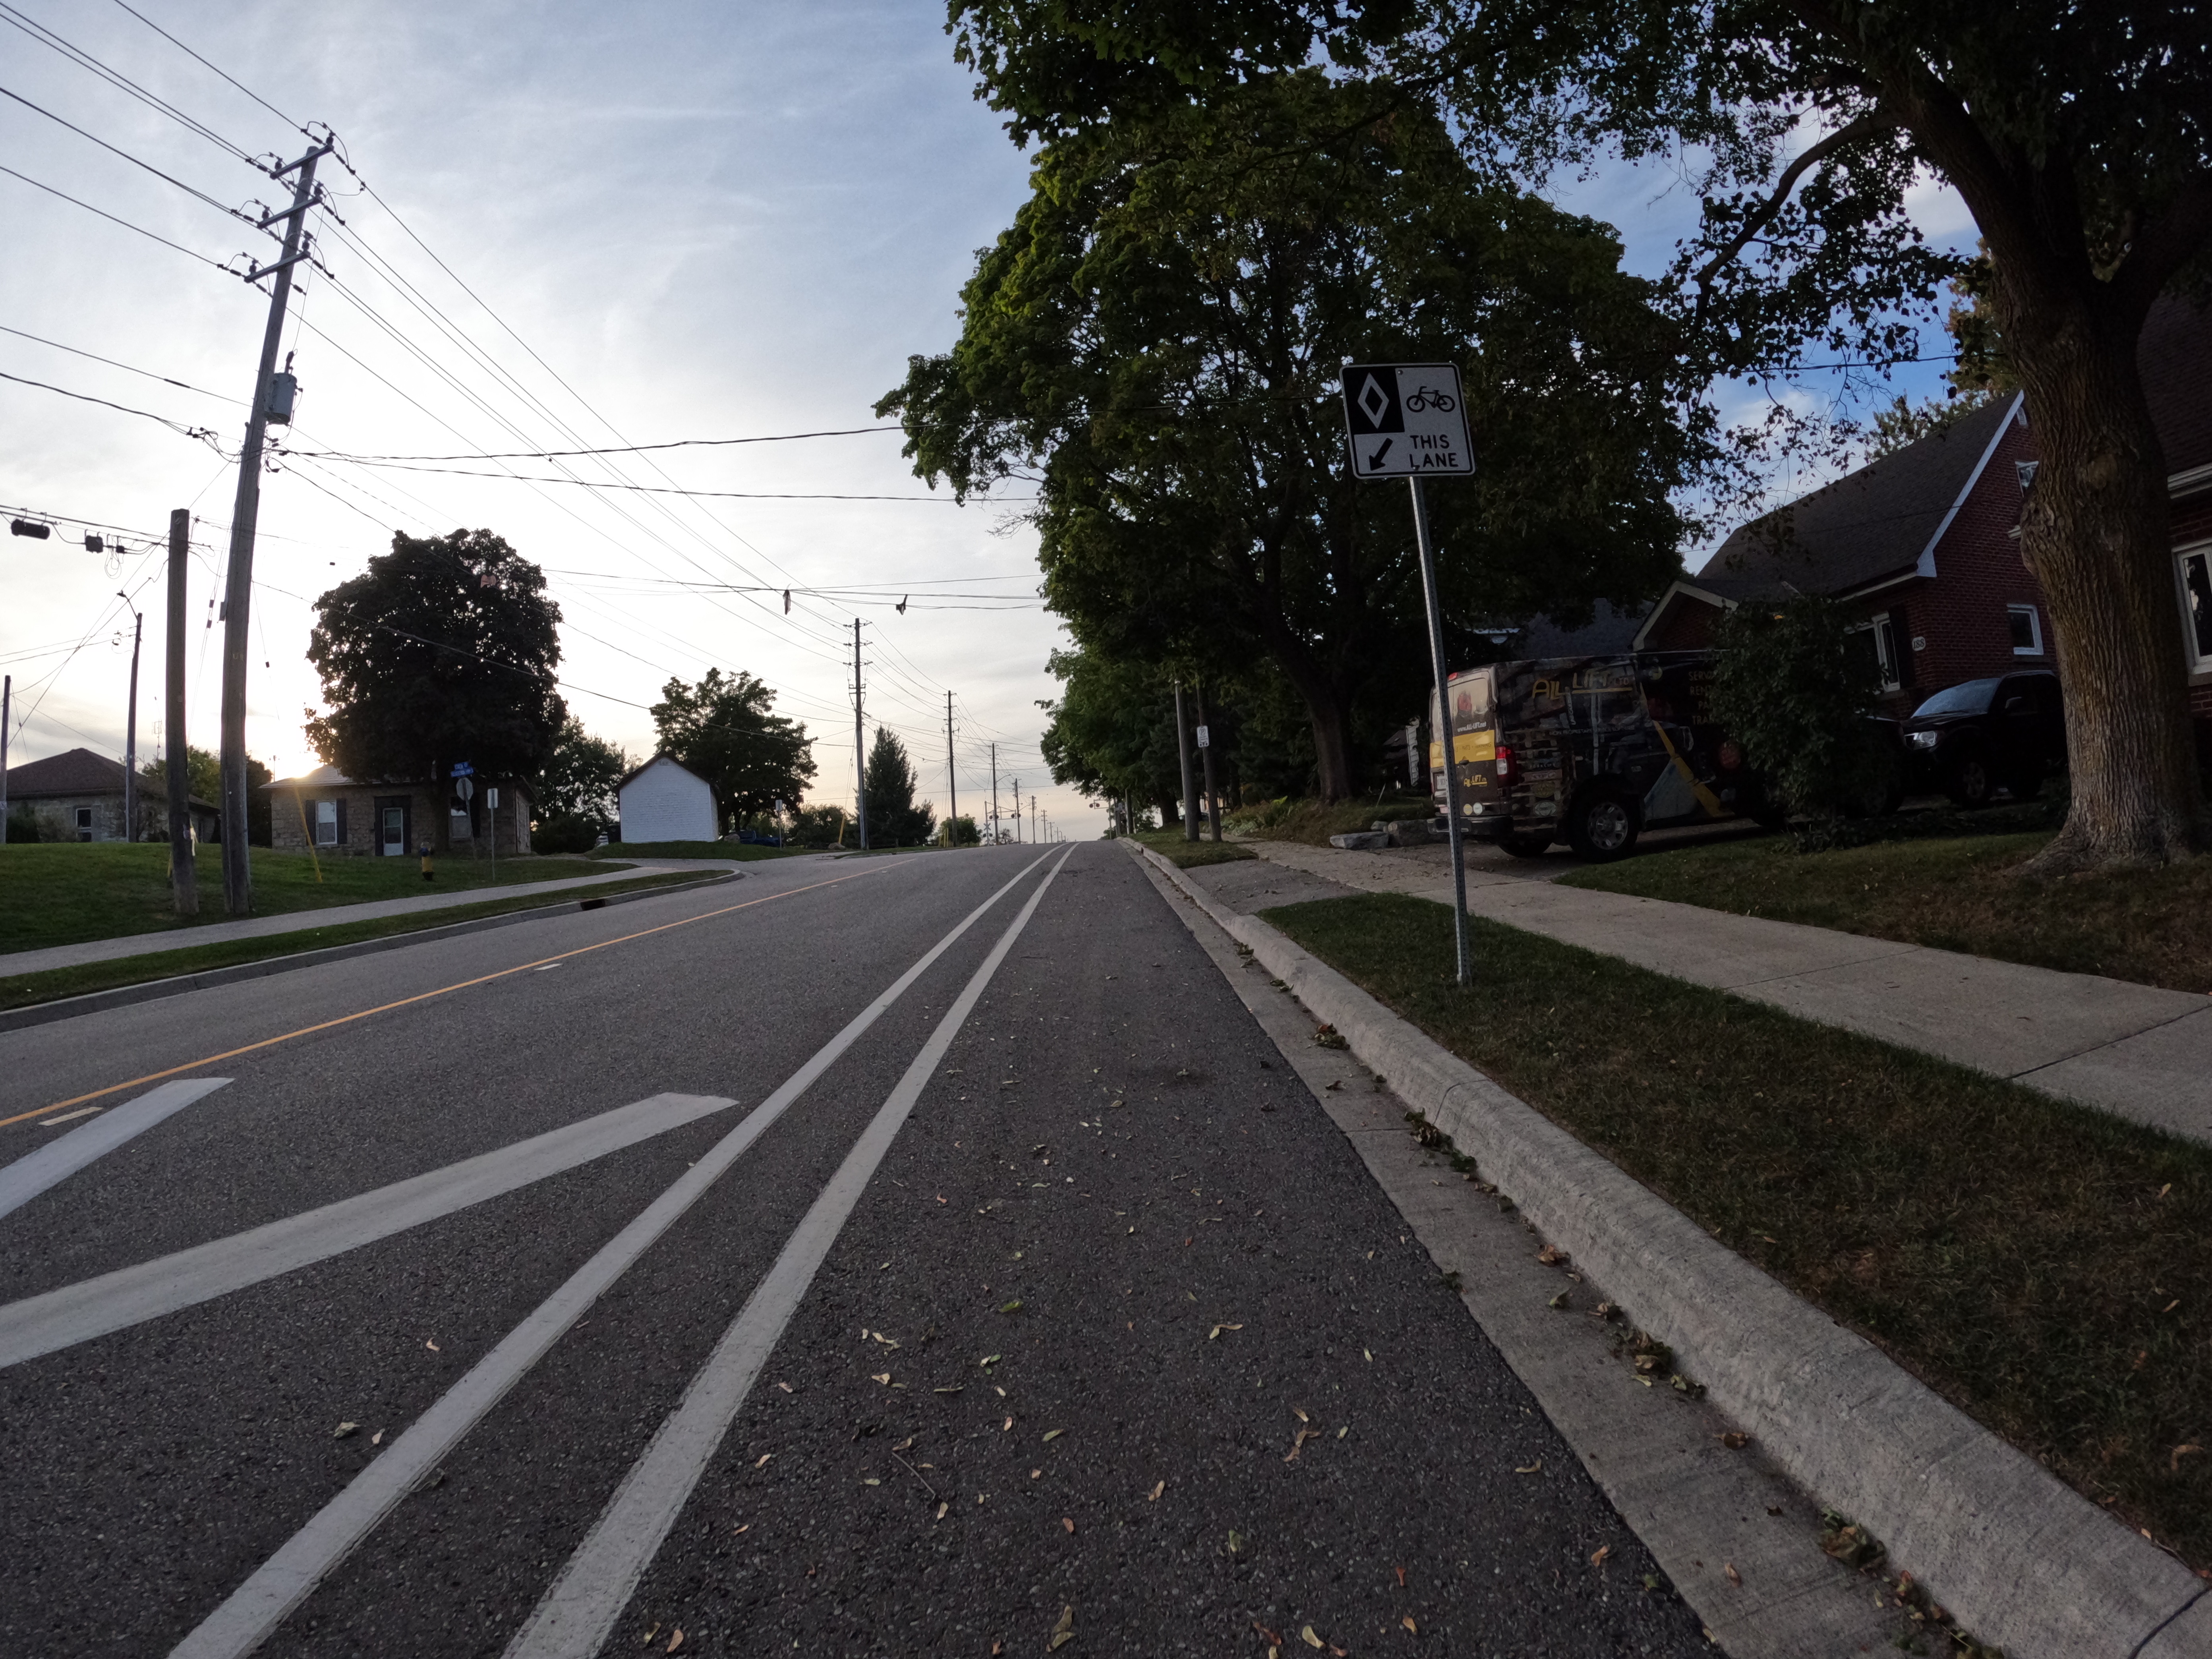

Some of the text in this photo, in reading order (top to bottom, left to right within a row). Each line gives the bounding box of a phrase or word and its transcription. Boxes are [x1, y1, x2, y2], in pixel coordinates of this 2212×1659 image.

[1410, 435, 1450, 449] THIS
[1409, 453, 1458, 468] LANE
[1914, 639, 1924, 648] 188
[1573, 668, 1610, 688] LIFT
